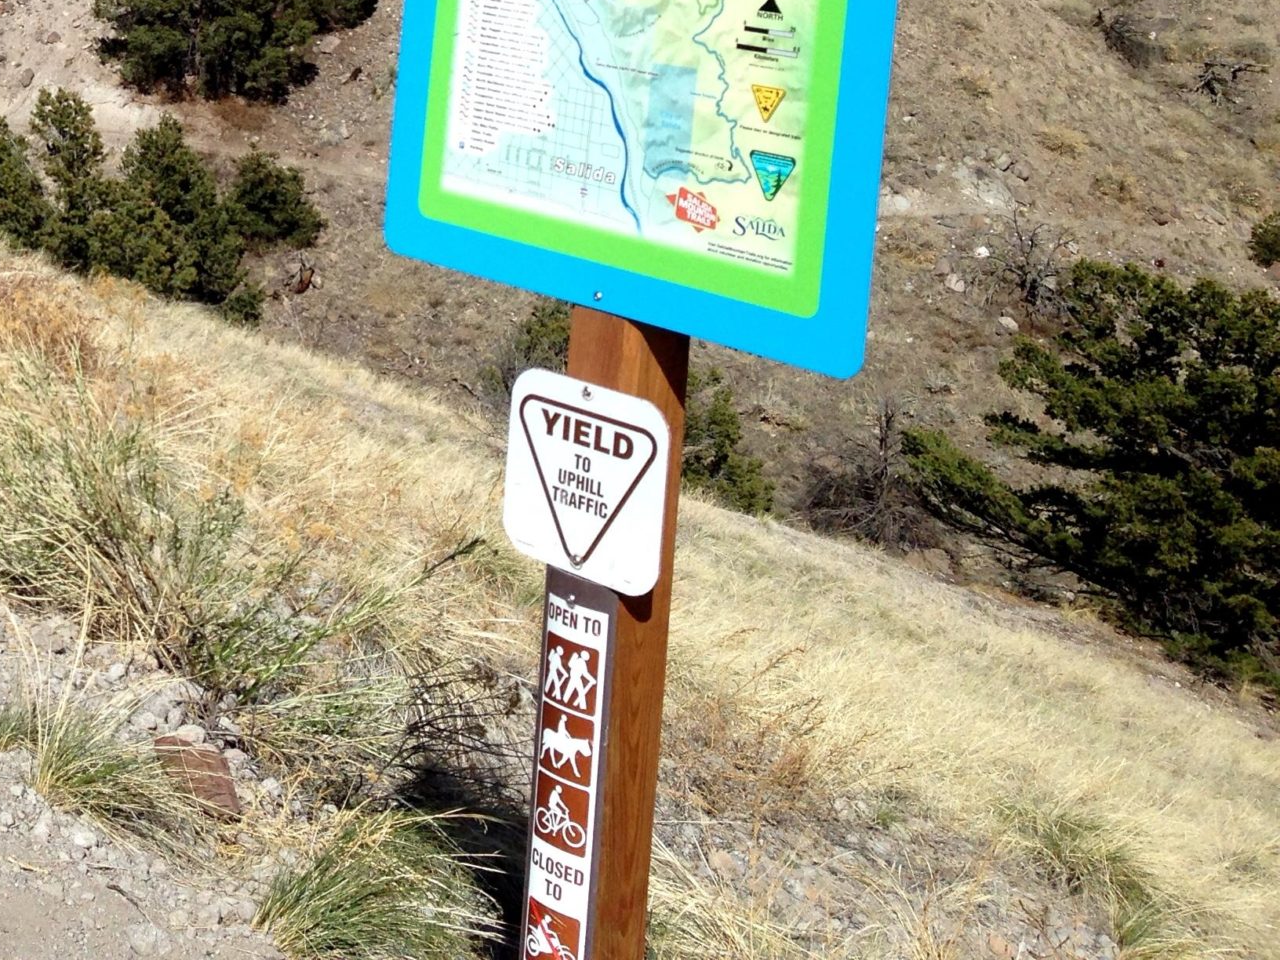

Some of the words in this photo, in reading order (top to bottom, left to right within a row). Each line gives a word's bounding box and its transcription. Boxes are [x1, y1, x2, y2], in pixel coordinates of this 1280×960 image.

[756, 11, 784, 21] NORTH
[553, 156, 616, 185] Salida
[732, 216, 786, 240] SALIDA
[541, 407, 634, 460] YIELD
[574, 453, 591, 473] TO
[558, 468, 604, 498] UPHILL
[552, 485, 608, 519] TRAFFIC
[549, 602, 578, 630] OPEN
[583, 616, 601, 637] TO
[532, 847, 584, 886] CLOSED
[545, 878, 562, 901] TO
